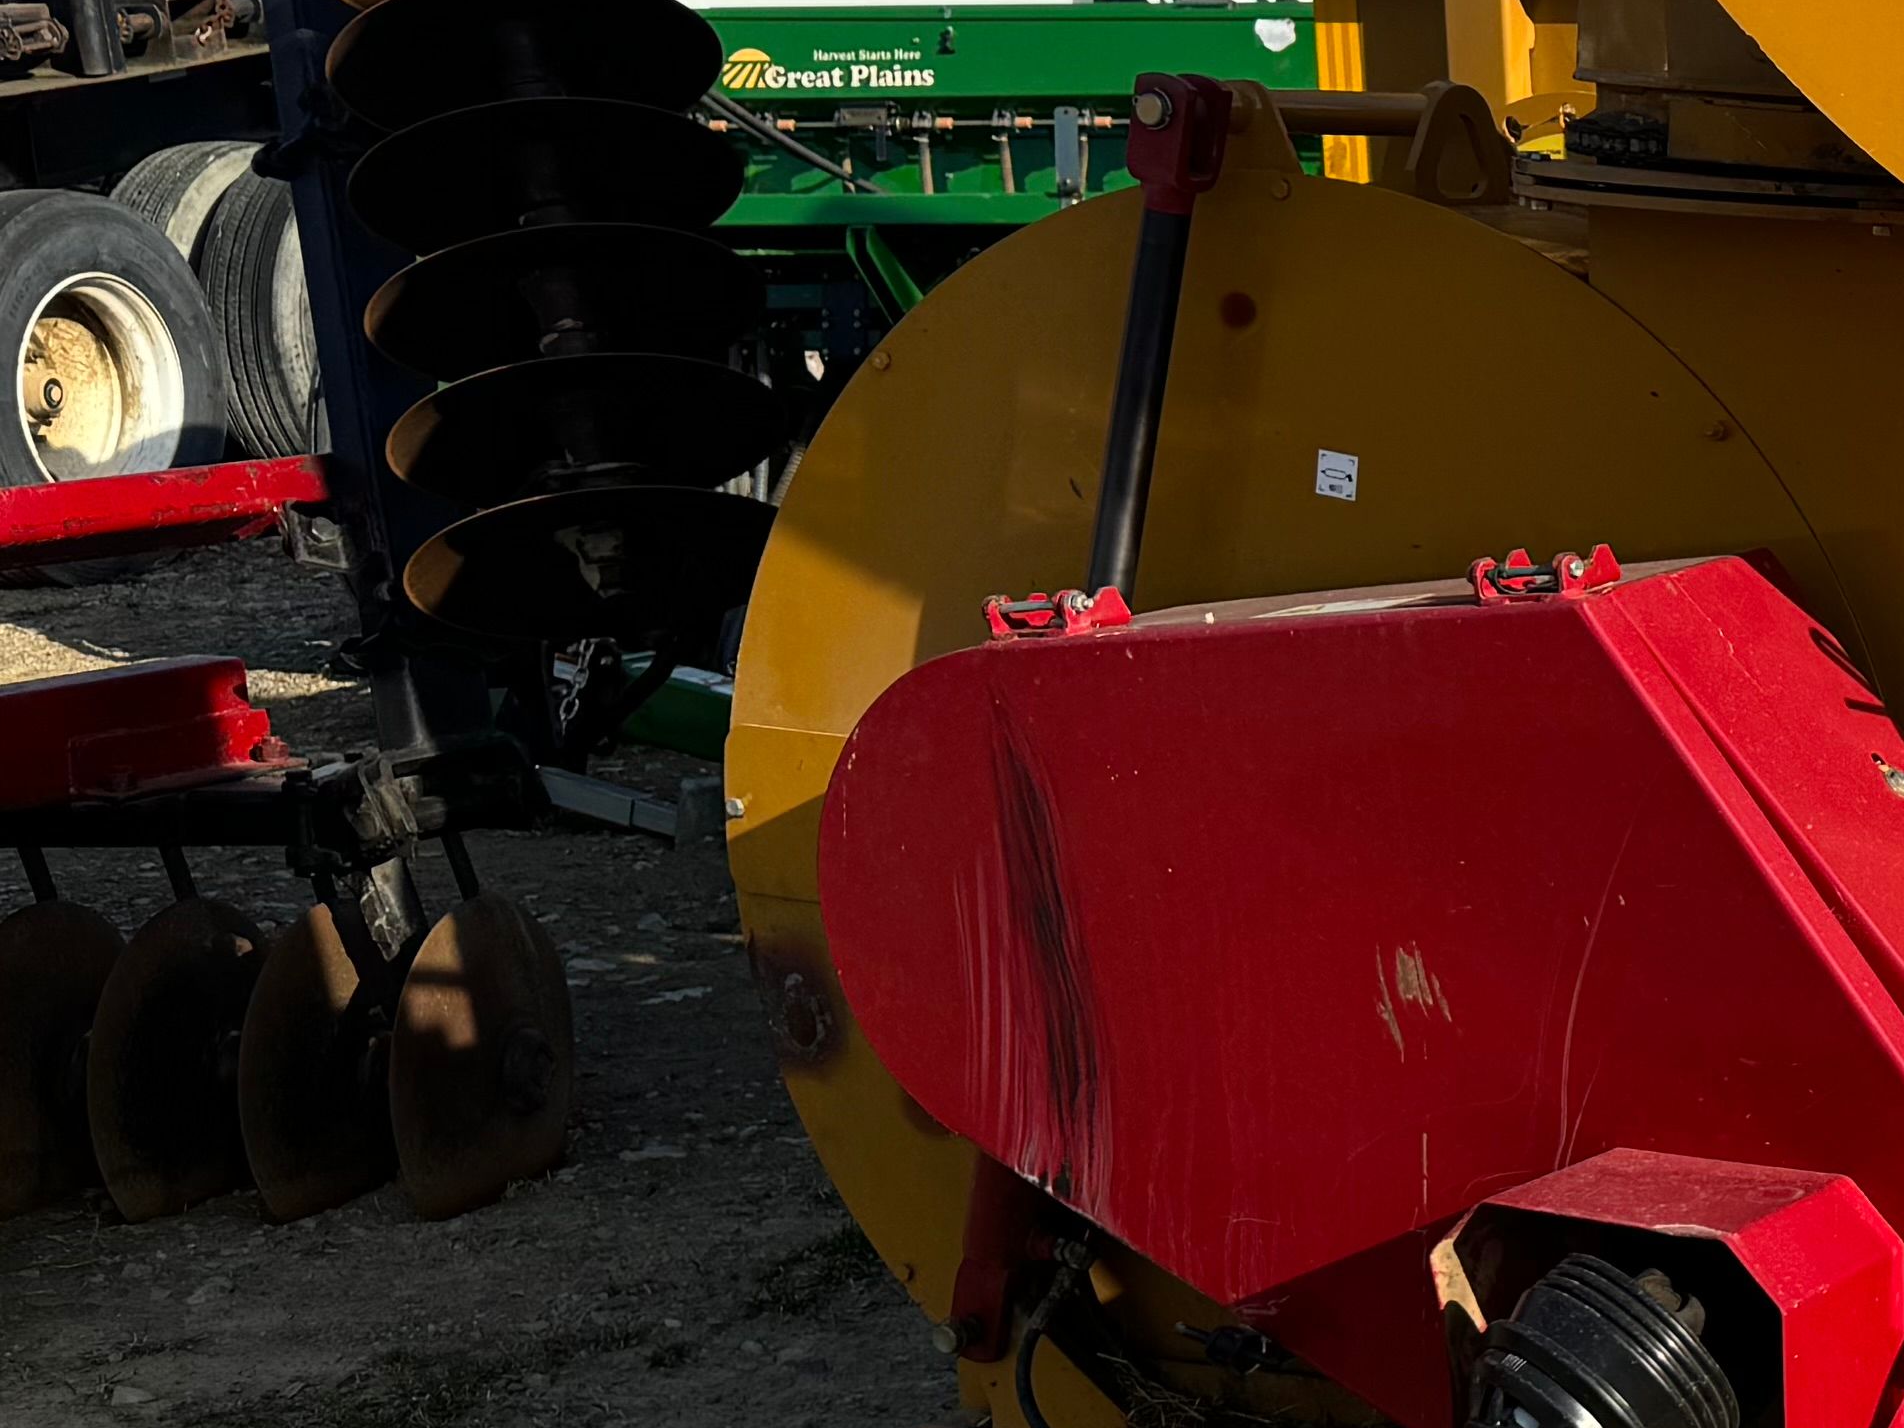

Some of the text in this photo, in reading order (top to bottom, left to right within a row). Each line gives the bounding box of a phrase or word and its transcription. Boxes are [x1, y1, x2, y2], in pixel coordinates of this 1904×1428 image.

[814, 48, 921, 61] Harvest Starts Here
[764, 64, 935, 89] Great Plains
